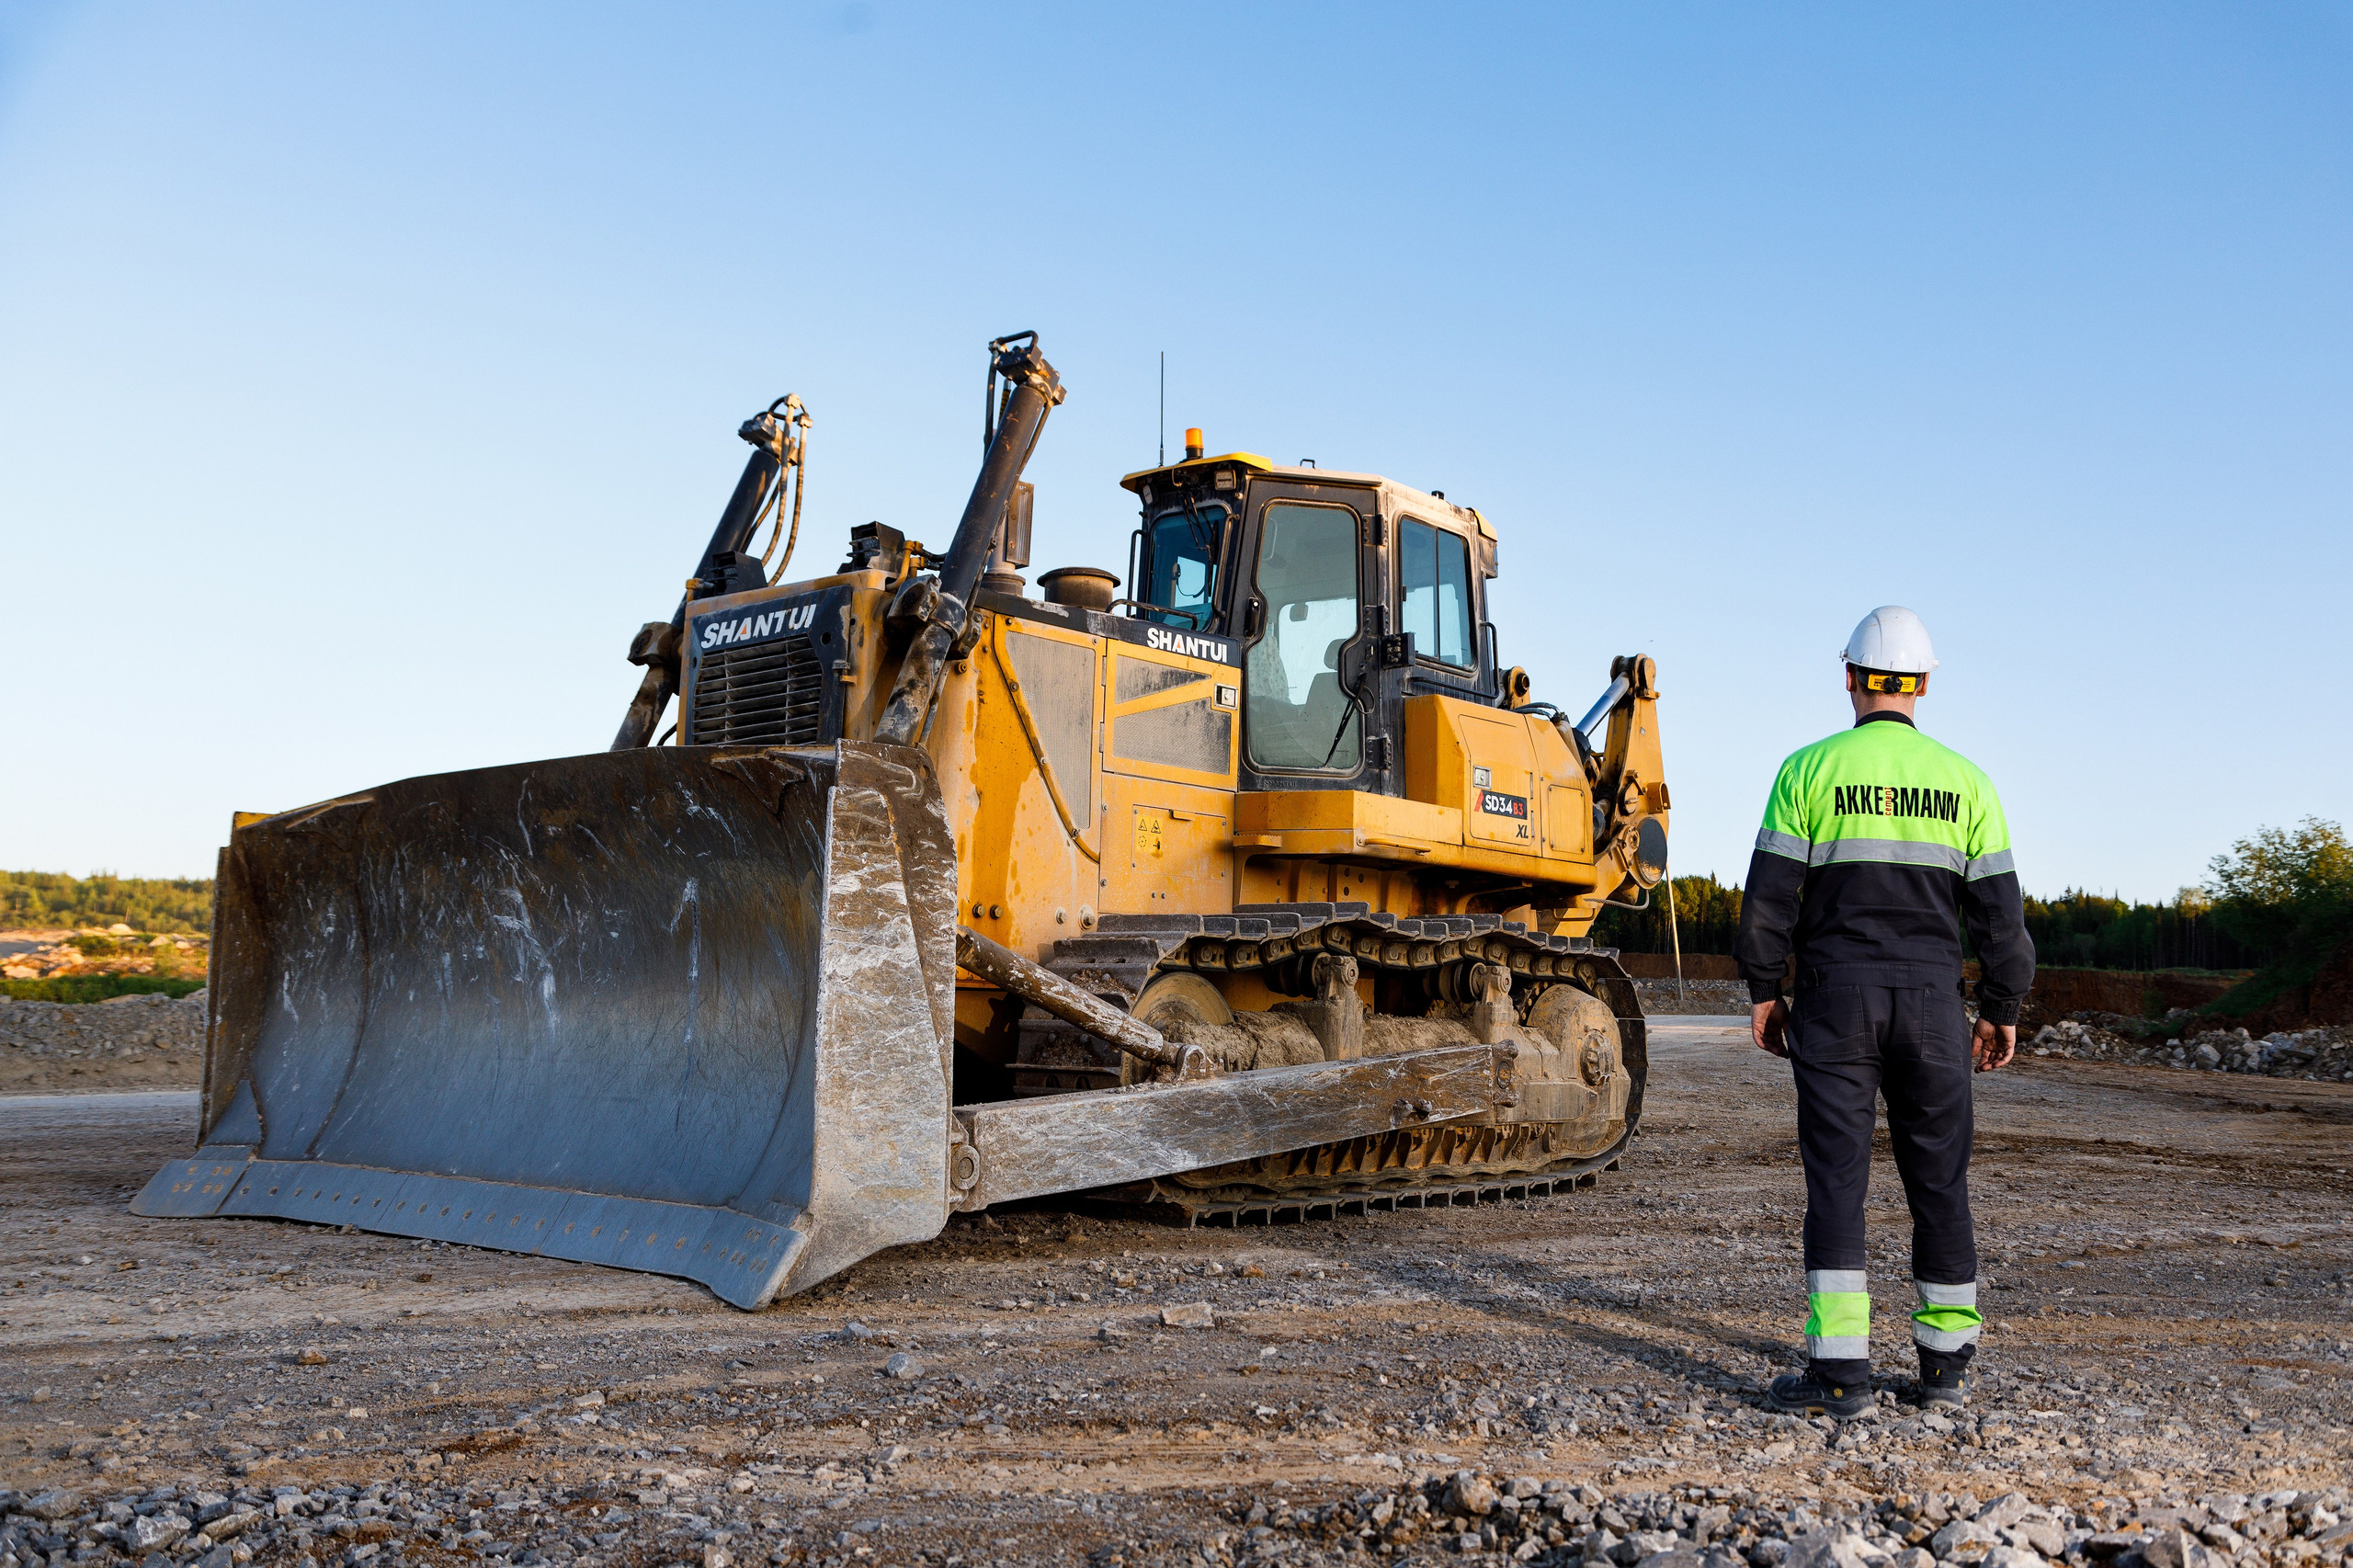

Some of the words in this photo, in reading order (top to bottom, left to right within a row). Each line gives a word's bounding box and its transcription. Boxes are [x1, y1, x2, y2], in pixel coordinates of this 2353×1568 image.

[700, 604, 817, 649] SHANTUI
[1146, 627, 1227, 663] SHANTUI
[1835, 784, 1961, 824] AKKERMANN
[1884, 787, 1893, 816] cement
[1516, 824, 1529, 838] XL
